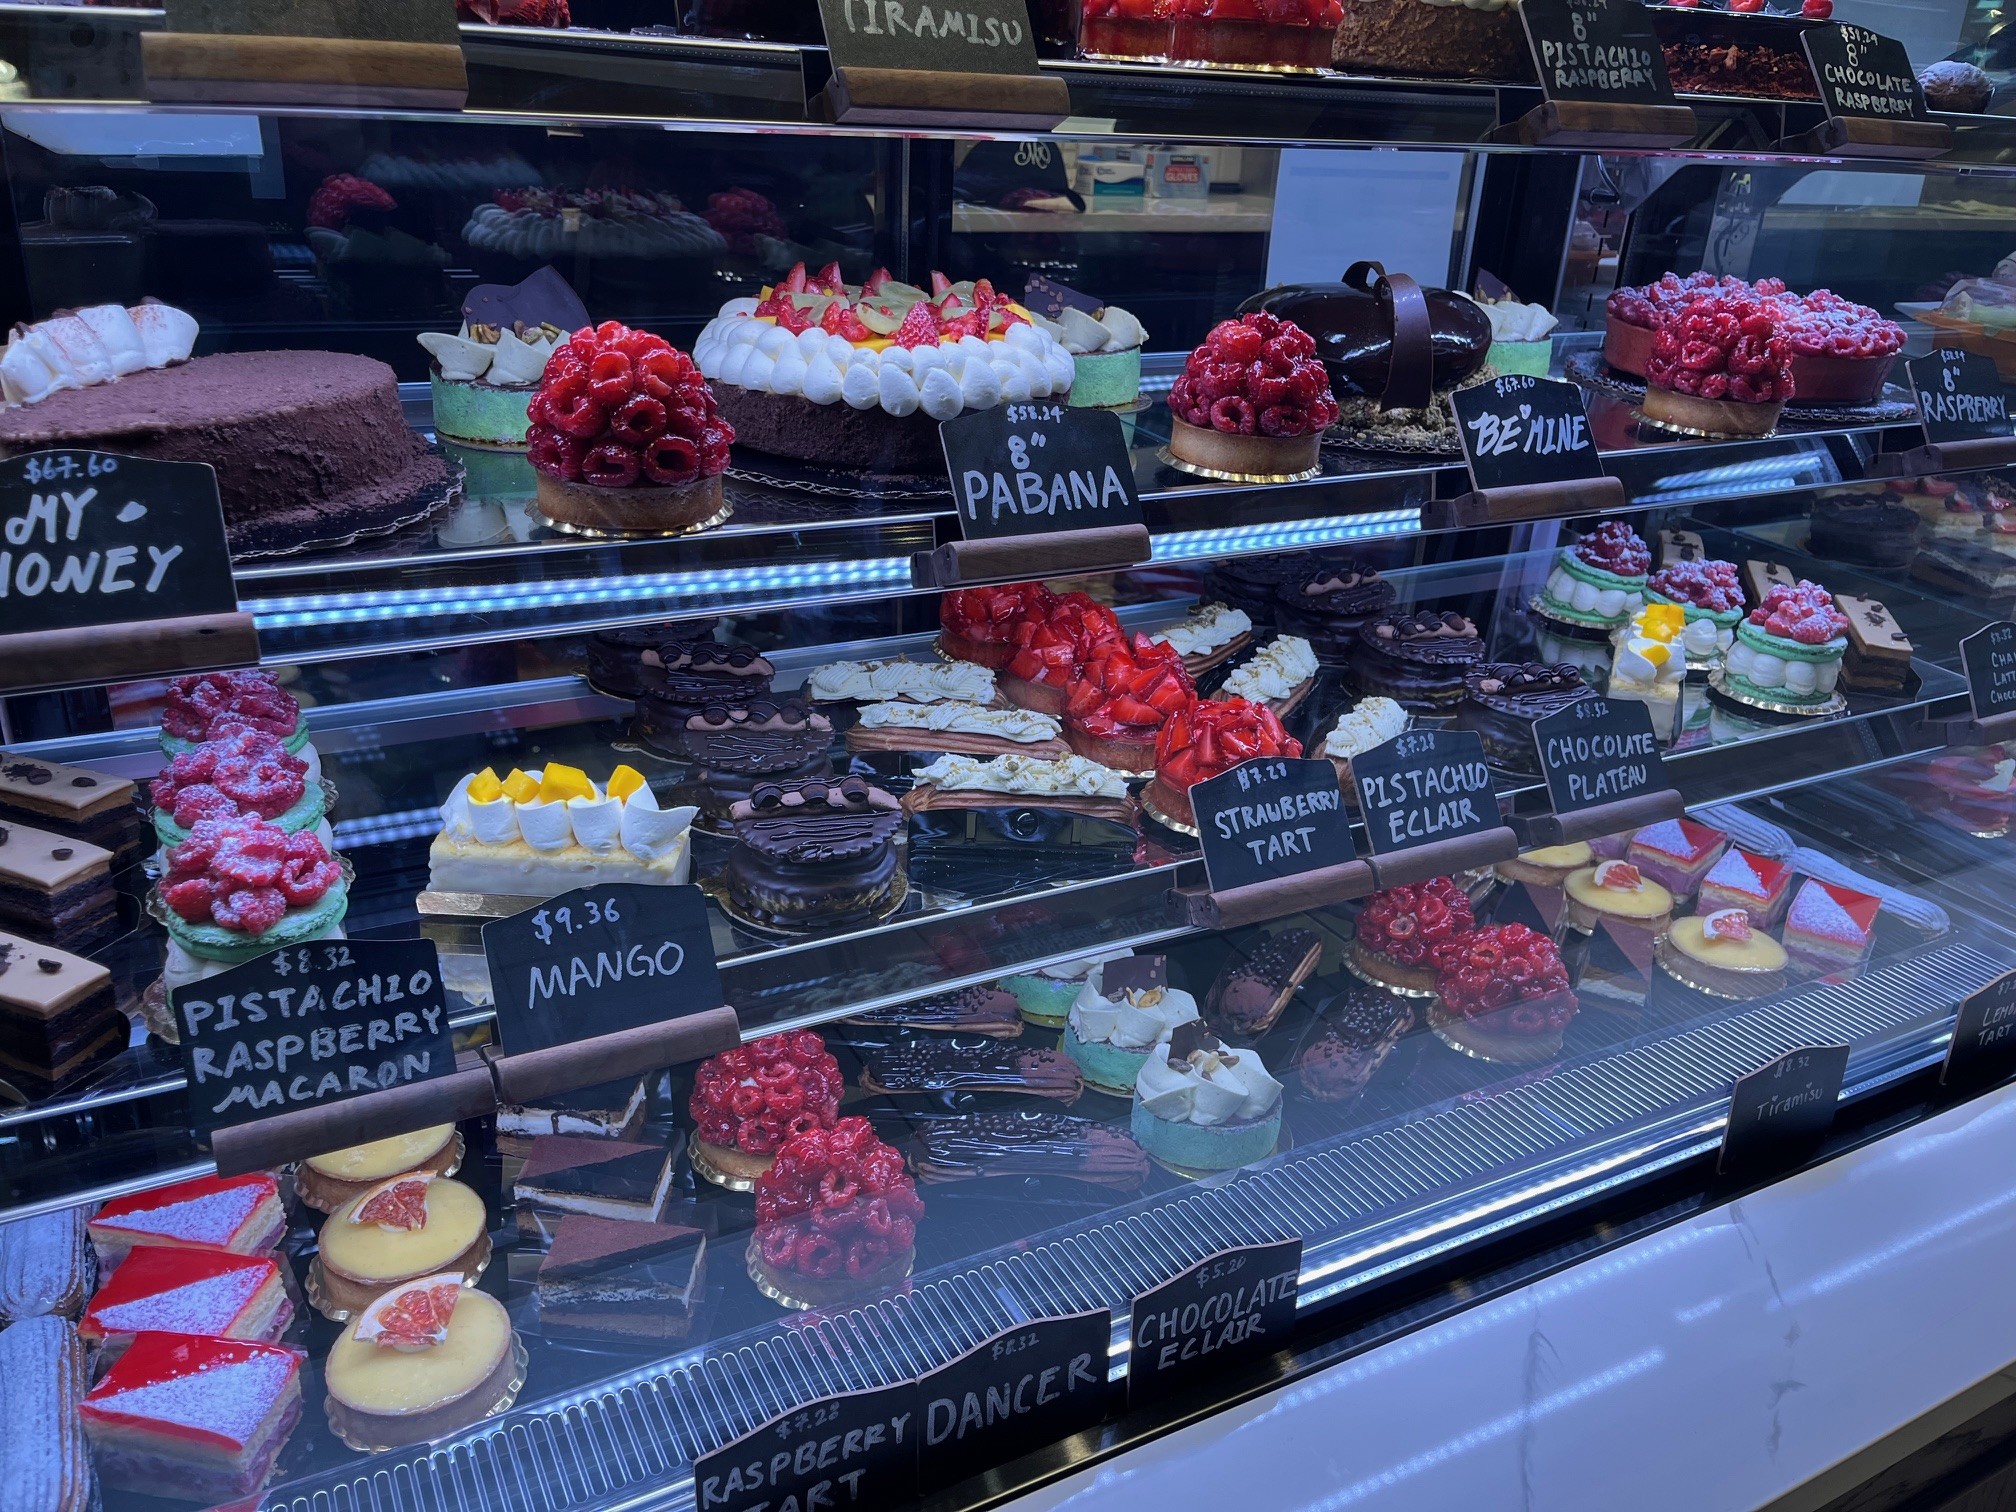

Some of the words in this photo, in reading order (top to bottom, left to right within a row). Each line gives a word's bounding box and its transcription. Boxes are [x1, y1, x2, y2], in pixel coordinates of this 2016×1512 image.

[1571, 11, 1597, 41] 8"
[1542, 39, 1651, 68] PISTACHIO
[1846, 43, 1867, 67] 8"
[1555, 66, 1657, 91] RASPBERRY
[1824, 63, 1913, 93] CHOCOLATE
[1834, 86, 1914, 118] RASPBERRY
[1494, 375, 1536, 398] $67.60
[1942, 365, 1961, 392] 8"
[1006, 404, 1065, 424] $58.24
[1920, 390, 2006, 423] RASPBERRY
[1007, 431, 1047, 470] 8"
[1467, 411, 1522, 457] BE
[1523, 412, 1590, 456] MINE
[22, 453, 118, 485] $67.60
[963, 465, 1130, 522] PABANA
[5, 487, 98, 545] MY
[1991, 651, 2016, 668] CHA
[1576, 701, 1609, 719] $8.32
[1395, 732, 1435, 758] $7.28
[1547, 732, 1655, 769] CHOCOLATE
[1236, 762, 1287, 792] $7.28
[1361, 762, 1489, 810] PISTACHIO
[1567, 763, 1647, 802] PLATEAU
[1214, 788, 1340, 840] STRAWBERRY
[1388, 797, 1481, 844] ECLAIR
[1246, 826, 1316, 866] TART
[531, 897, 620, 945] $9.36
[271, 946, 356, 977] $8.32
[528, 940, 685, 1010] MANGO
[182, 969, 434, 1036] PISTACHIO
[192, 1004, 442, 1084] RASPBERRY
[1978, 1022, 2014, 1047] TART
[212, 1051, 431, 1114] MACARON
[1757, 1081, 1823, 1121] Tiramisu
[1195, 1256, 1247, 1289] $5.20
[1137, 1268, 1298, 1348] CHOCOLATE
[1157, 1312, 1266, 1370] ECLAIR
[926, 1352, 1098, 1446] DANCER
[775, 1401, 840, 1440] $7.28
[702, 1411, 911, 1510] RASPBERRY
